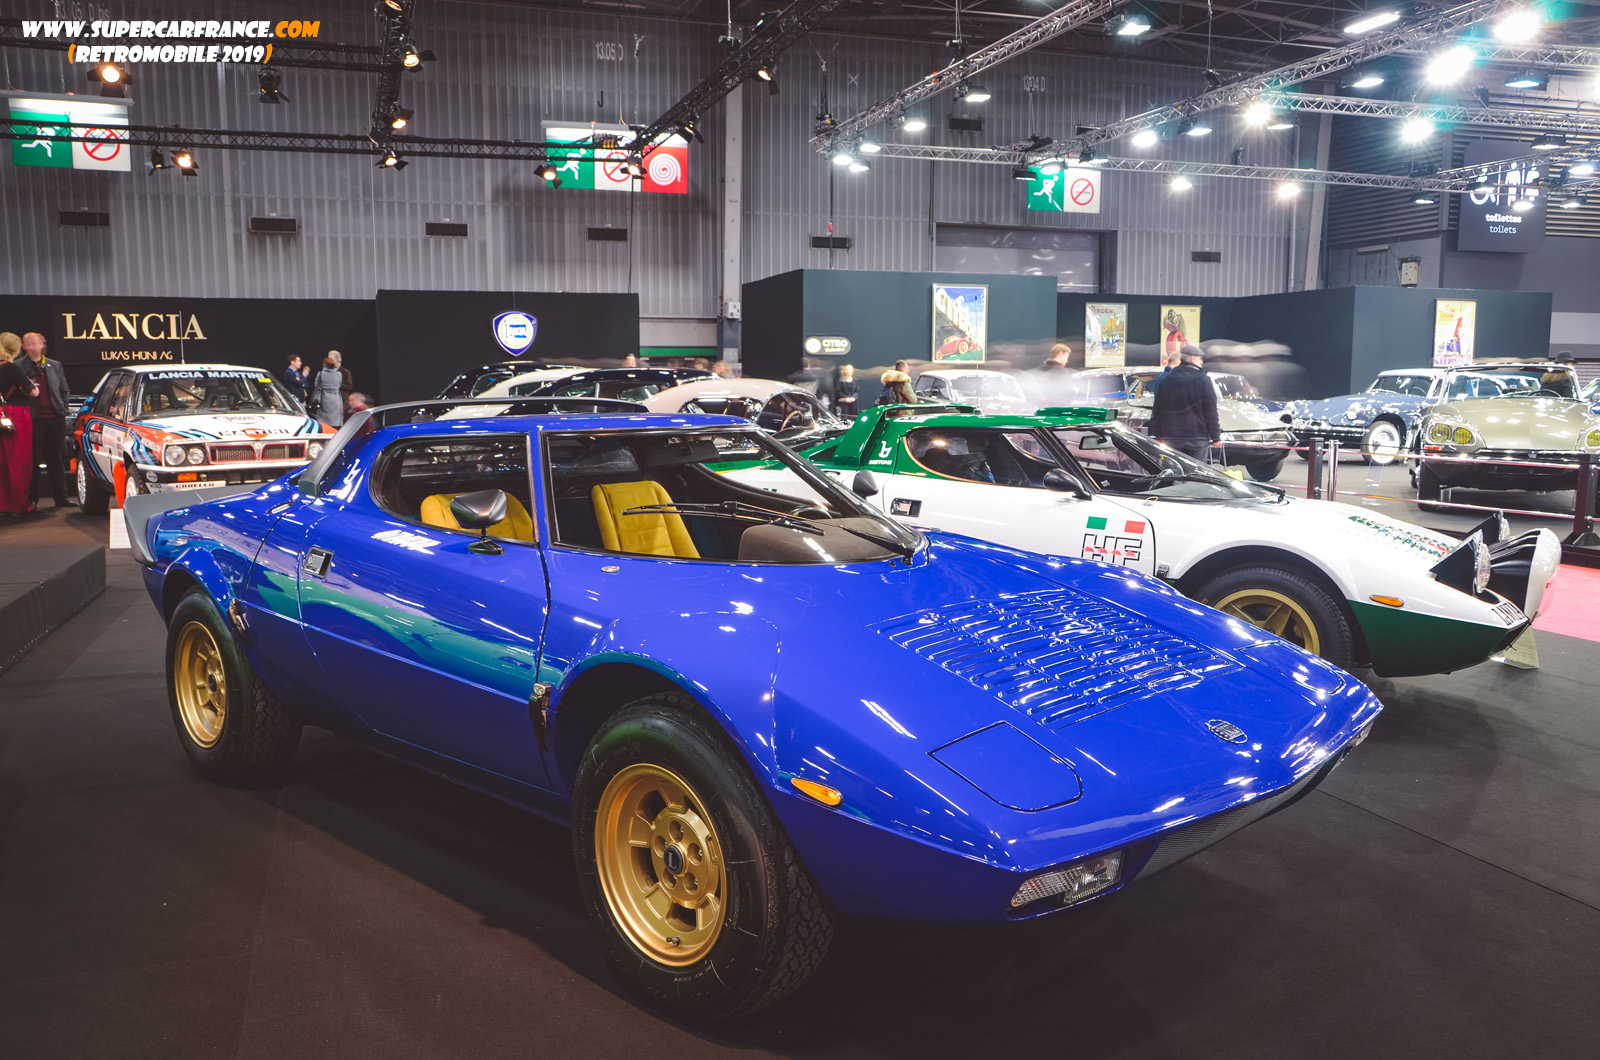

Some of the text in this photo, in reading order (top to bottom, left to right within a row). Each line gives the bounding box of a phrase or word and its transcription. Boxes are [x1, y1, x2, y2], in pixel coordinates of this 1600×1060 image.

[1490, 225, 1517, 234] toilets
[62, 313, 207, 340] LANCIA
[101, 351, 173, 360] LUKAS HÜNI AG
[149, 371, 265, 380] LANCIA MARTINI
[668, 851, 678, 869] L
